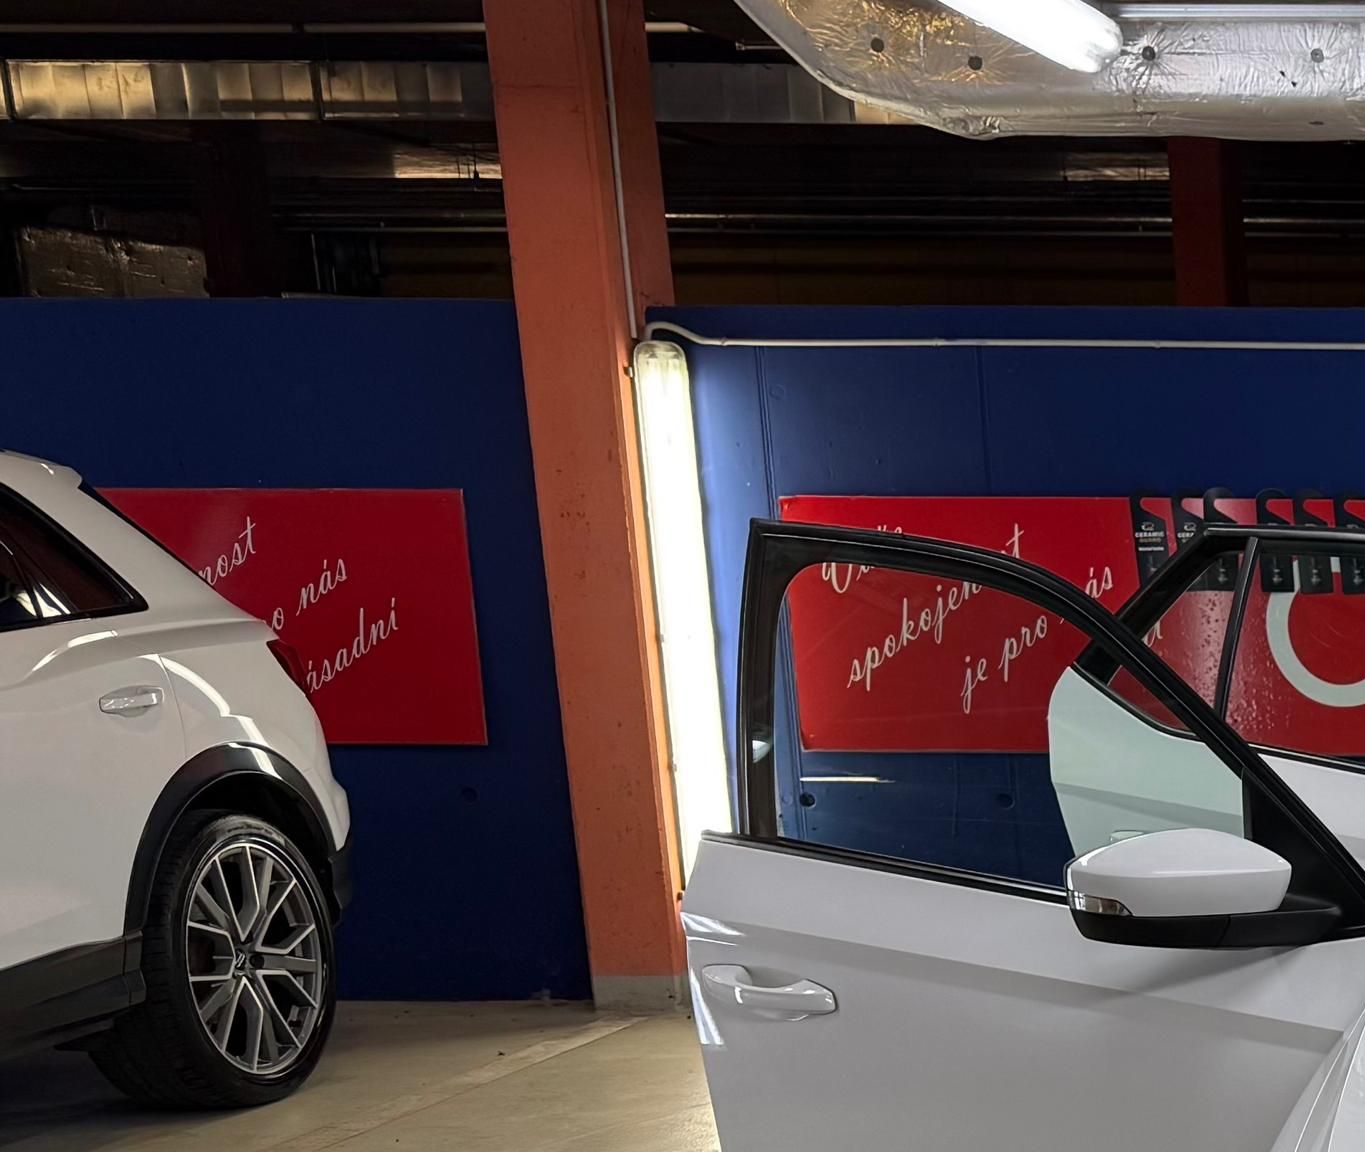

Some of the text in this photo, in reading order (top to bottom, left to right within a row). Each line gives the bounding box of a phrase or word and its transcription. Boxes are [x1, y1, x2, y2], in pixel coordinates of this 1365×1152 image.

[295, 558, 348, 617] nás
[960, 655, 989, 715] je
[998, 615, 1048, 683] pro
